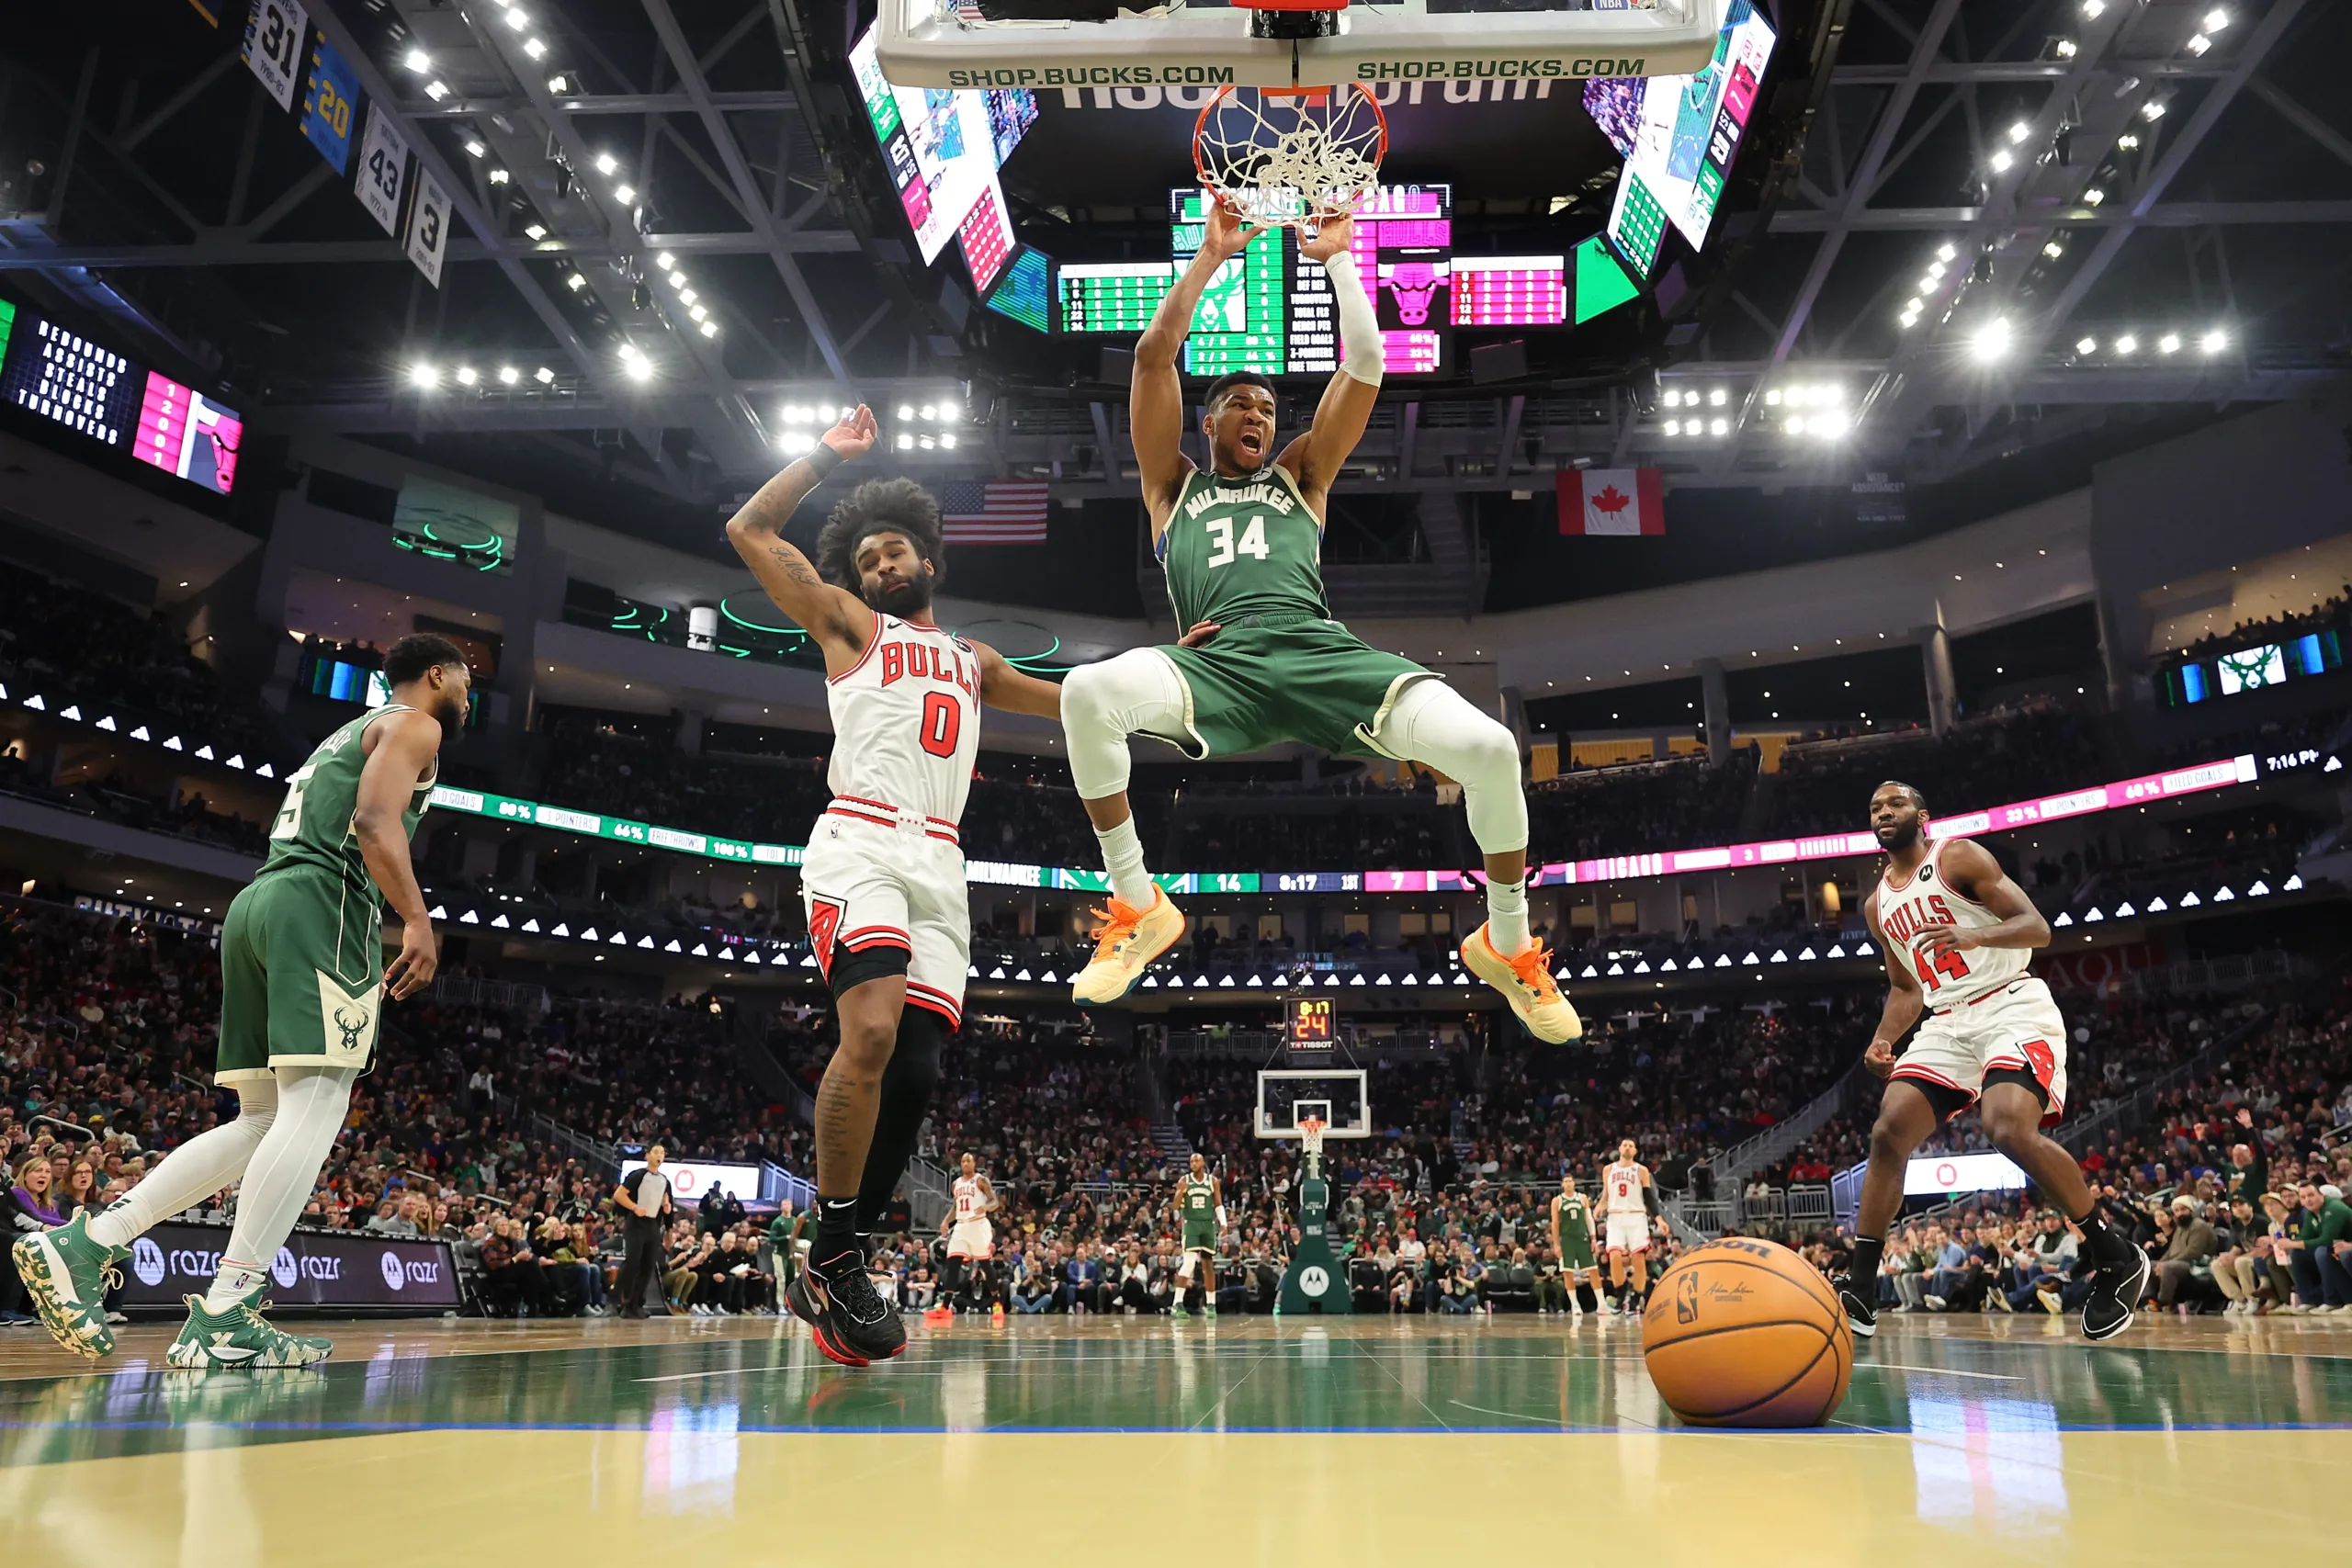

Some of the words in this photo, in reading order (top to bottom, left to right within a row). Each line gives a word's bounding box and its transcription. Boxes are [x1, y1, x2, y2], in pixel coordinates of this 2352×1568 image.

[262, 5, 296, 78] 31
[949, 66, 1234, 86] SHOP.BUCKS.COM
[1357, 59, 1645, 79] SHOP.BUCKS.COM
[319, 79, 350, 140] 20
[368, 148, 399, 200] 43
[421, 203, 440, 253] 3
[1290, 294, 1332, 304] TURNOVERS
[1294, 307, 1315, 318] TOTAL
[1317, 307, 1329, 318] FLS
[1292, 321, 1316, 332] BENCH
[1317, 321, 1331, 332] PTS
[38, 321, 127, 374] REBOUNDS
[1290, 334, 1309, 345] FIELD
[1311, 334, 1334, 345] GOALS
[1290, 347, 1334, 358] 3-POINTERS
[42, 342, 116, 387] ASSISTS
[1288, 361, 1305, 372] FREE
[1306, 361, 1336, 372] THROWS
[45, 362, 107, 401] STEALS
[167, 383, 175, 397] 1
[40, 378, 105, 420] BLOCKS
[161, 400, 173, 414] 2
[17, 389, 118, 445] TURNOVERS
[158, 416, 169, 431] 0
[154, 434, 165, 448] 0
[153, 452, 163, 465] 1
[1184, 483, 1295, 520] MILWAUKEE
[1205, 515, 1270, 569] 34
[881, 641, 981, 716] BULLS
[920, 691, 961, 759] 0
[2267, 753, 2297, 771] 7:16
[2194, 767, 2224, 787] GOALS
[269, 761, 319, 840] 5
[449, 792, 476, 808] GOALS
[555, 812, 594, 830] POINTERS
[652, 829, 672, 846] FREE
[671, 833, 699, 850] THROWS
[966, 861, 1041, 886] MILWAUKEE
[1585, 852, 1662, 882] CHICAGO
[1217, 875, 1241, 891] 14
[1279, 874, 1317, 891] 8:17
[1341, 875, 1359, 890] 1ST
[1391, 874, 1403, 890] 7
[1883, 895, 1958, 951] BULLS
[1912, 942, 1970, 992] 44
[1300, 1001, 1329, 1015] 8:17
[1296, 1015, 1326, 1038] 24
[1302, 1041, 1333, 1049] TISSOT
[1619, 1183, 1627, 1197] 9
[960, 1198, 970, 1212] 11
[1192, 1196, 1205, 1209] 22
[170, 1250, 220, 1276] razr
[300, 1255, 342, 1280] razr
[405, 1261, 438, 1282] razr
